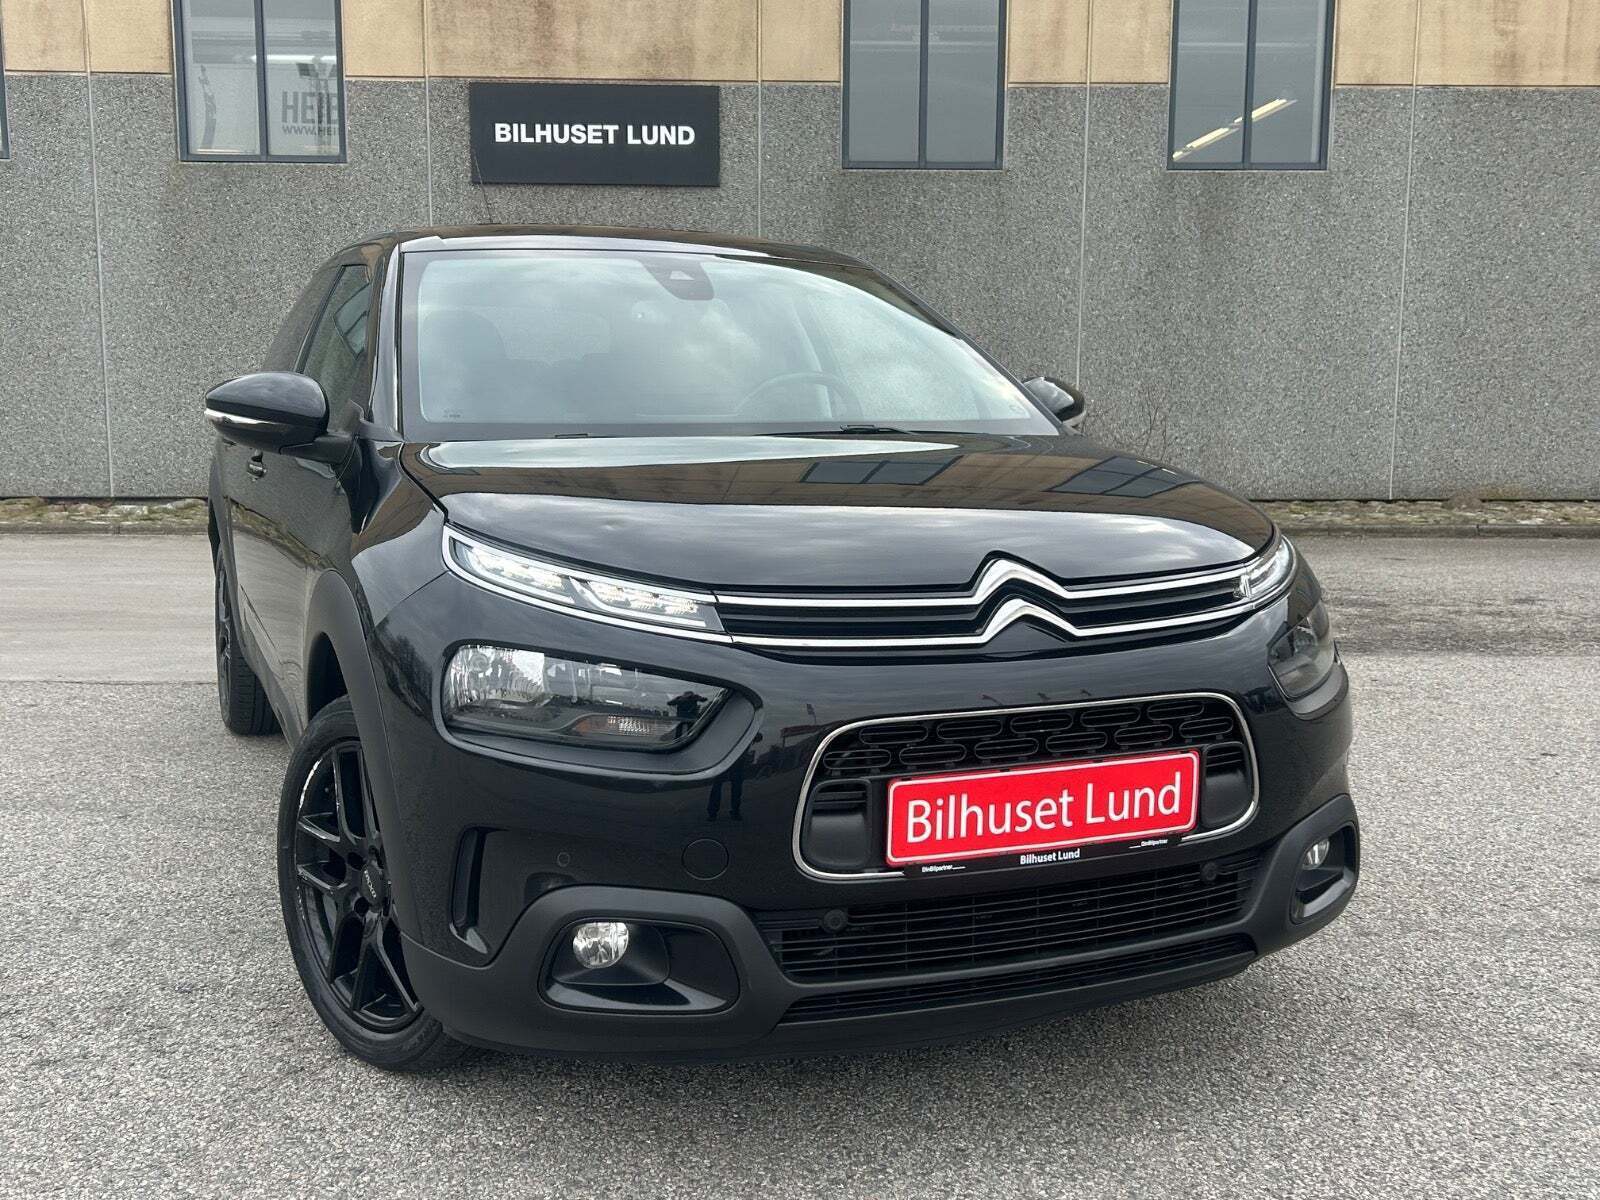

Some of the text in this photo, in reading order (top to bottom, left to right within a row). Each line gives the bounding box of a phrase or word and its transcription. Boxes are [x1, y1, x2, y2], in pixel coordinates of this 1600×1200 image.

[494, 122, 696, 146] BILHUSET LUND
[906, 771, 1181, 843] Bilhuset Lund
[1020, 848, 1081, 865] Bilhuset Lund
